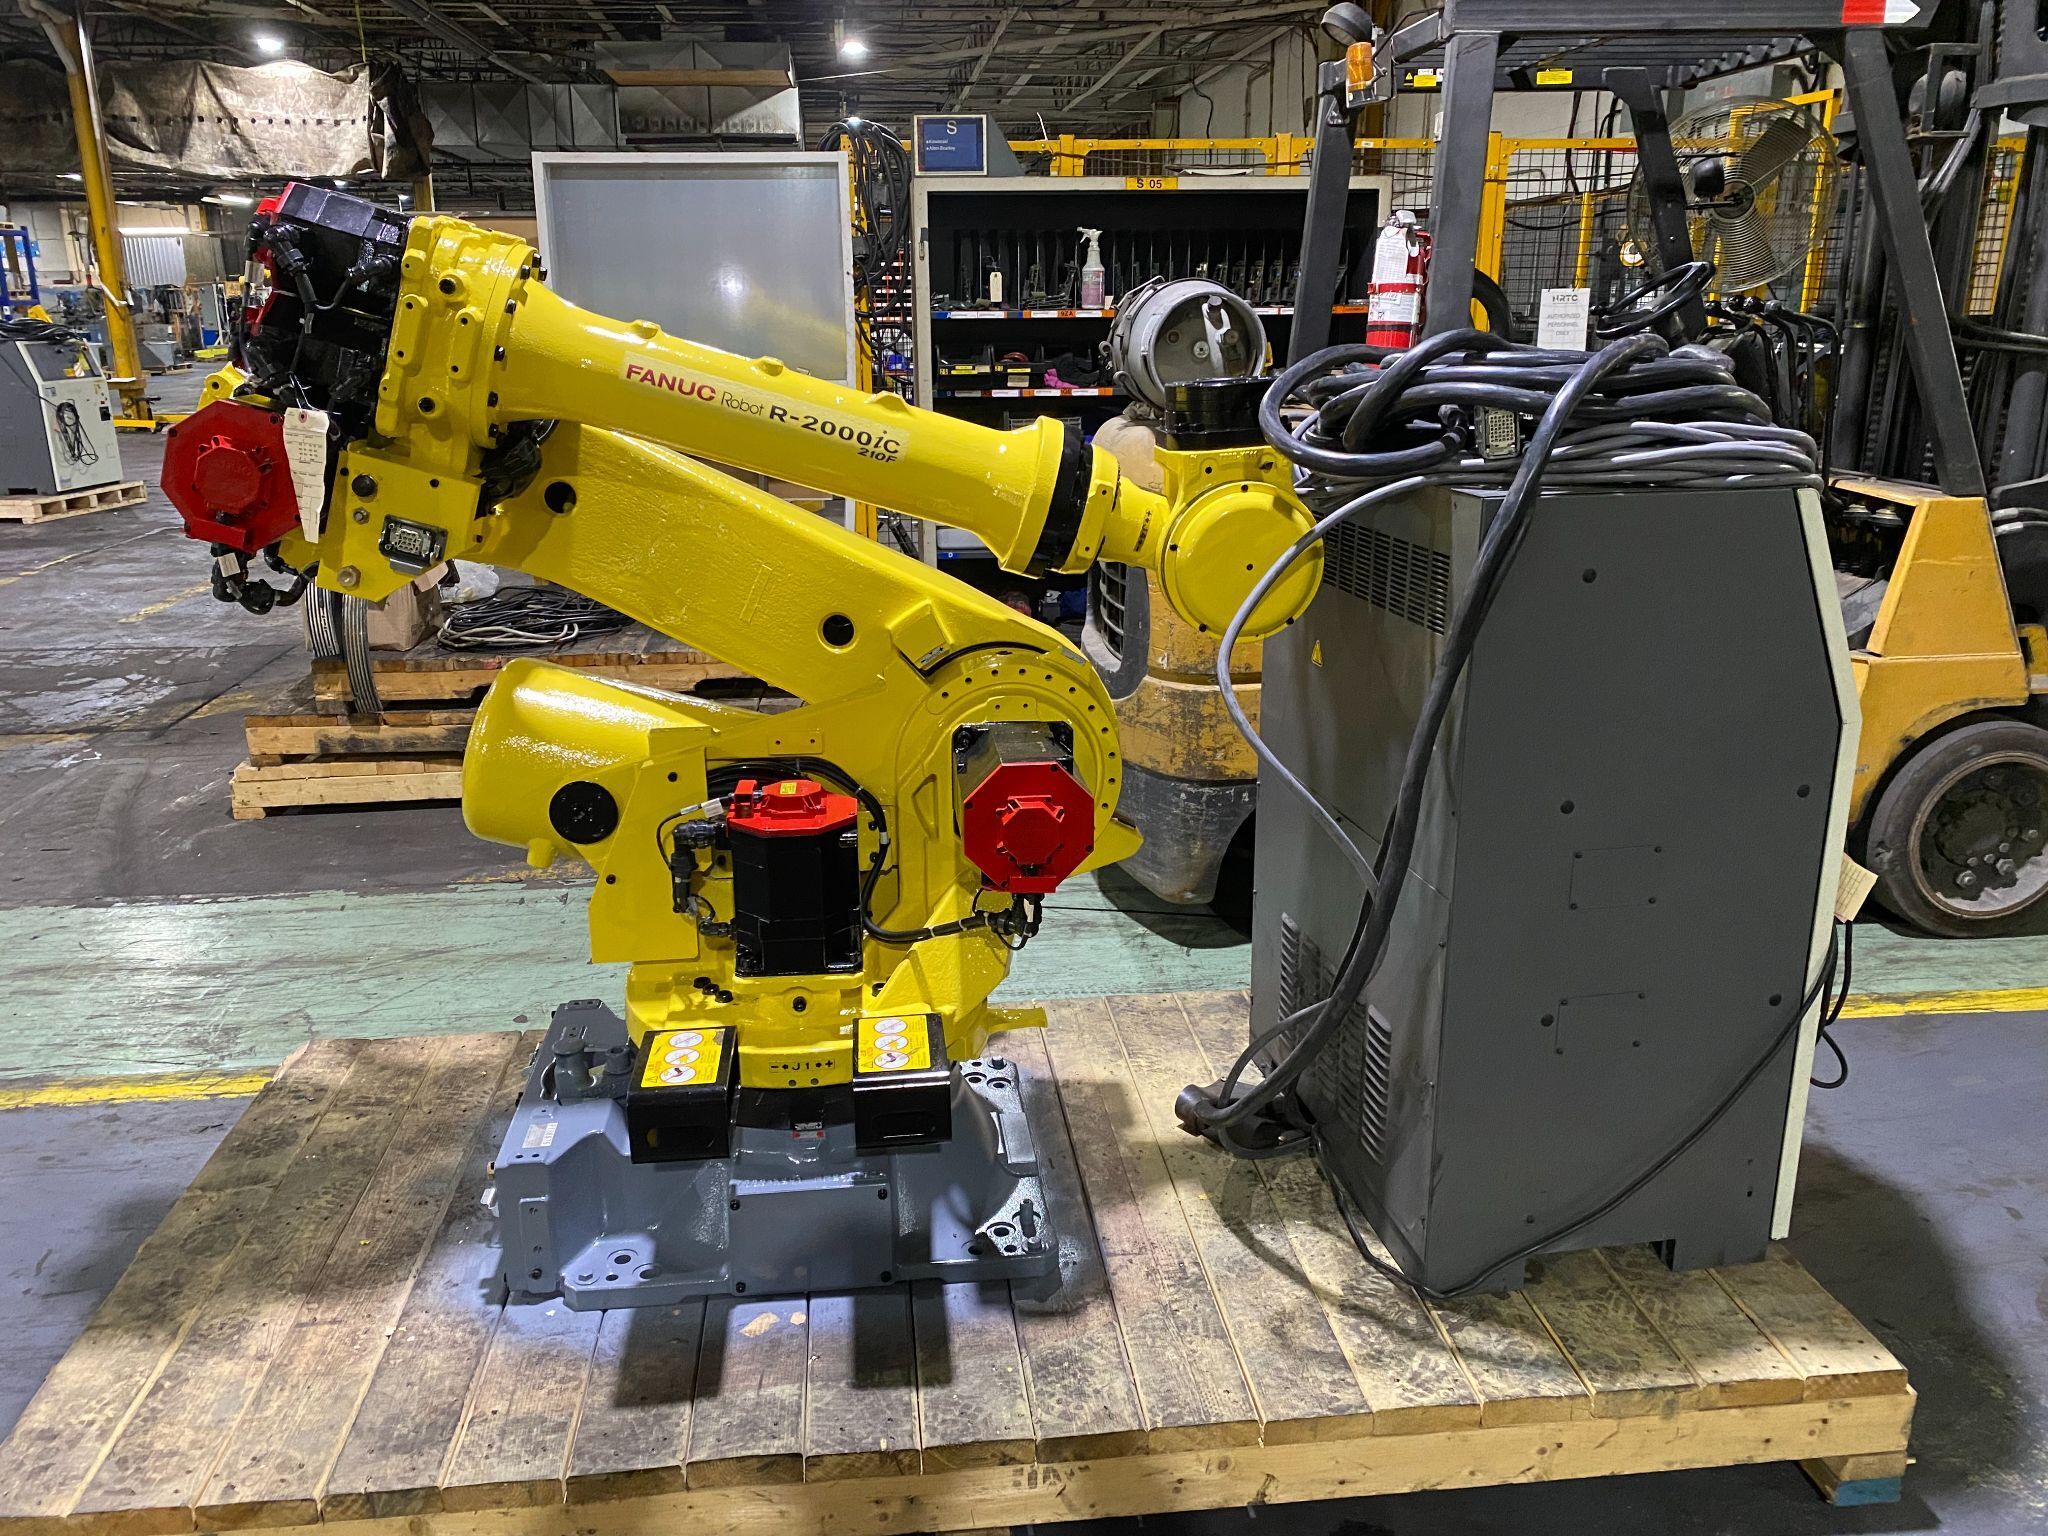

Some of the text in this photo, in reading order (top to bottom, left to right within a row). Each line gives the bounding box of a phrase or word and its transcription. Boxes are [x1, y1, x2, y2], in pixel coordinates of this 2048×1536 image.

[946, 120, 958, 135] S
[1136, 178, 1163, 189] S 05
[1552, 294, 1579, 302] NRTC
[626, 364, 901, 454] FANUC Robot R-2000iC
[857, 447, 898, 463] 210F
